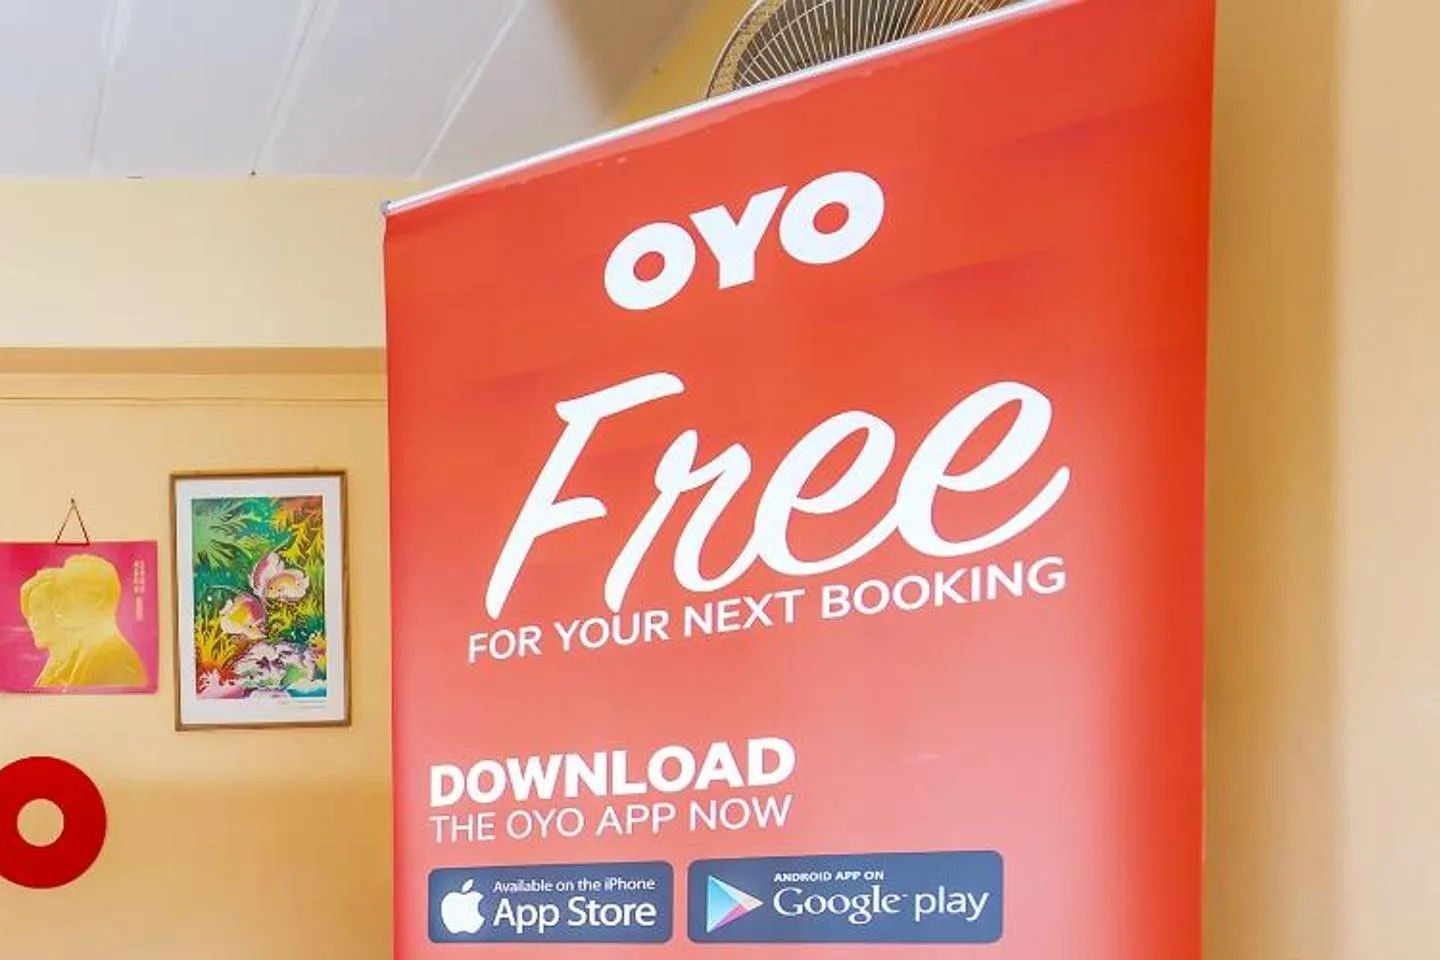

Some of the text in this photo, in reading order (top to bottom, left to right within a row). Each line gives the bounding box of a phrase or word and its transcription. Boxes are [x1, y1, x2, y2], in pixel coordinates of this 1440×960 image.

[604, 171, 885, 310] OYO
[485, 372, 1071, 618] Free
[467, 556, 1066, 663] FOR YOUR NEXT BOOKING
[429, 737, 796, 808] DOWNLOAD
[429, 795, 793, 842] THE OYO APP NOW
[494, 876, 656, 893] Available on the iPhone
[774, 870, 884, 882] ANDROID APP ON
[493, 895, 658, 934] App Store
[773, 885, 990, 925] Google play
